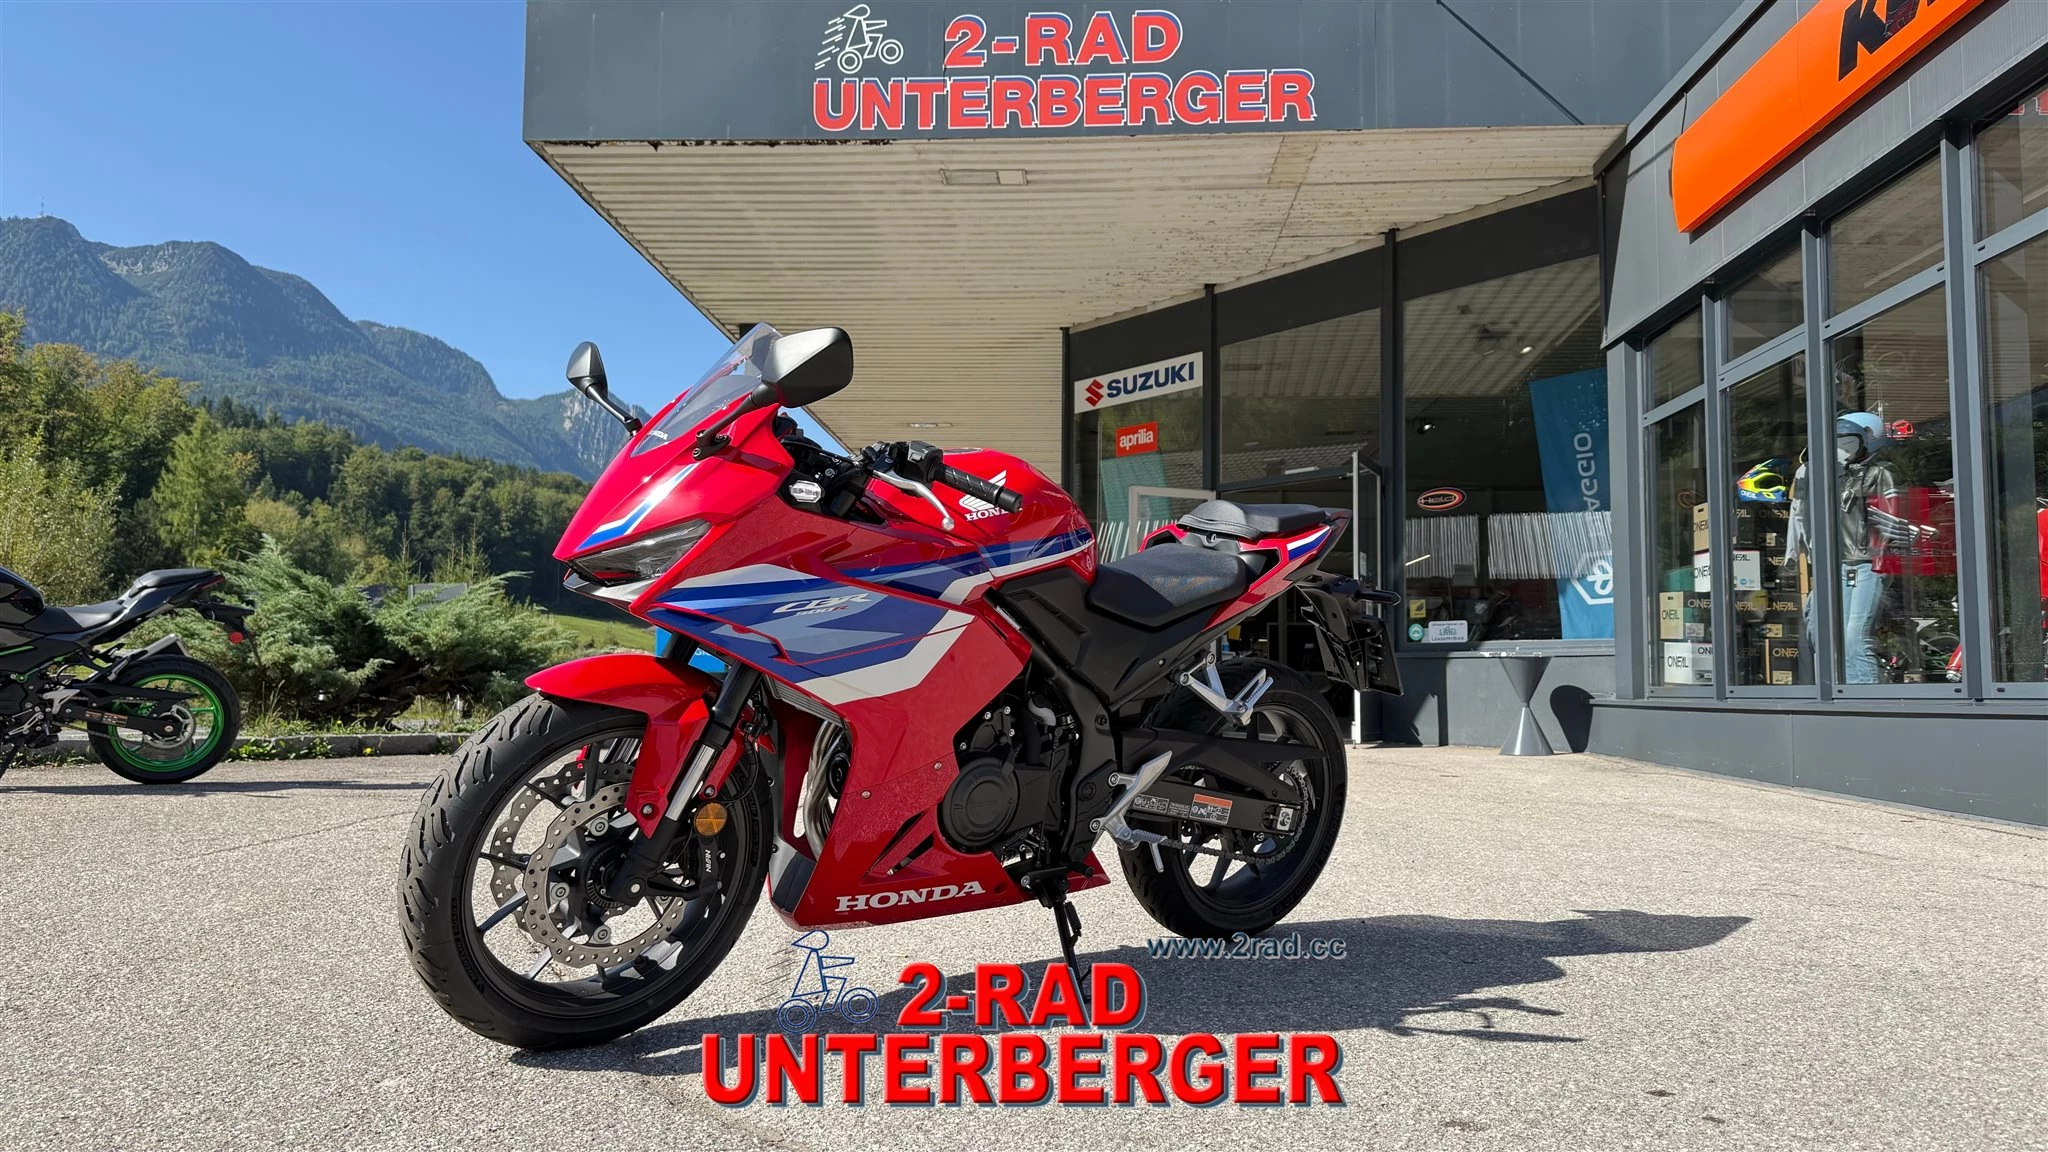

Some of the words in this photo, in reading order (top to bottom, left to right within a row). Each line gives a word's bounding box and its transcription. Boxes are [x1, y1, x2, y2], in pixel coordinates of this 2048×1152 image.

[944, 9, 1184, 69] 2-RAD
[813, 69, 1317, 130] UNTERBERGER
[1106, 361, 1195, 399] SUZUKI
[1119, 428, 1154, 451] aprilia
[772, 593, 873, 614] CBR
[834, 881, 986, 912] HONDA
